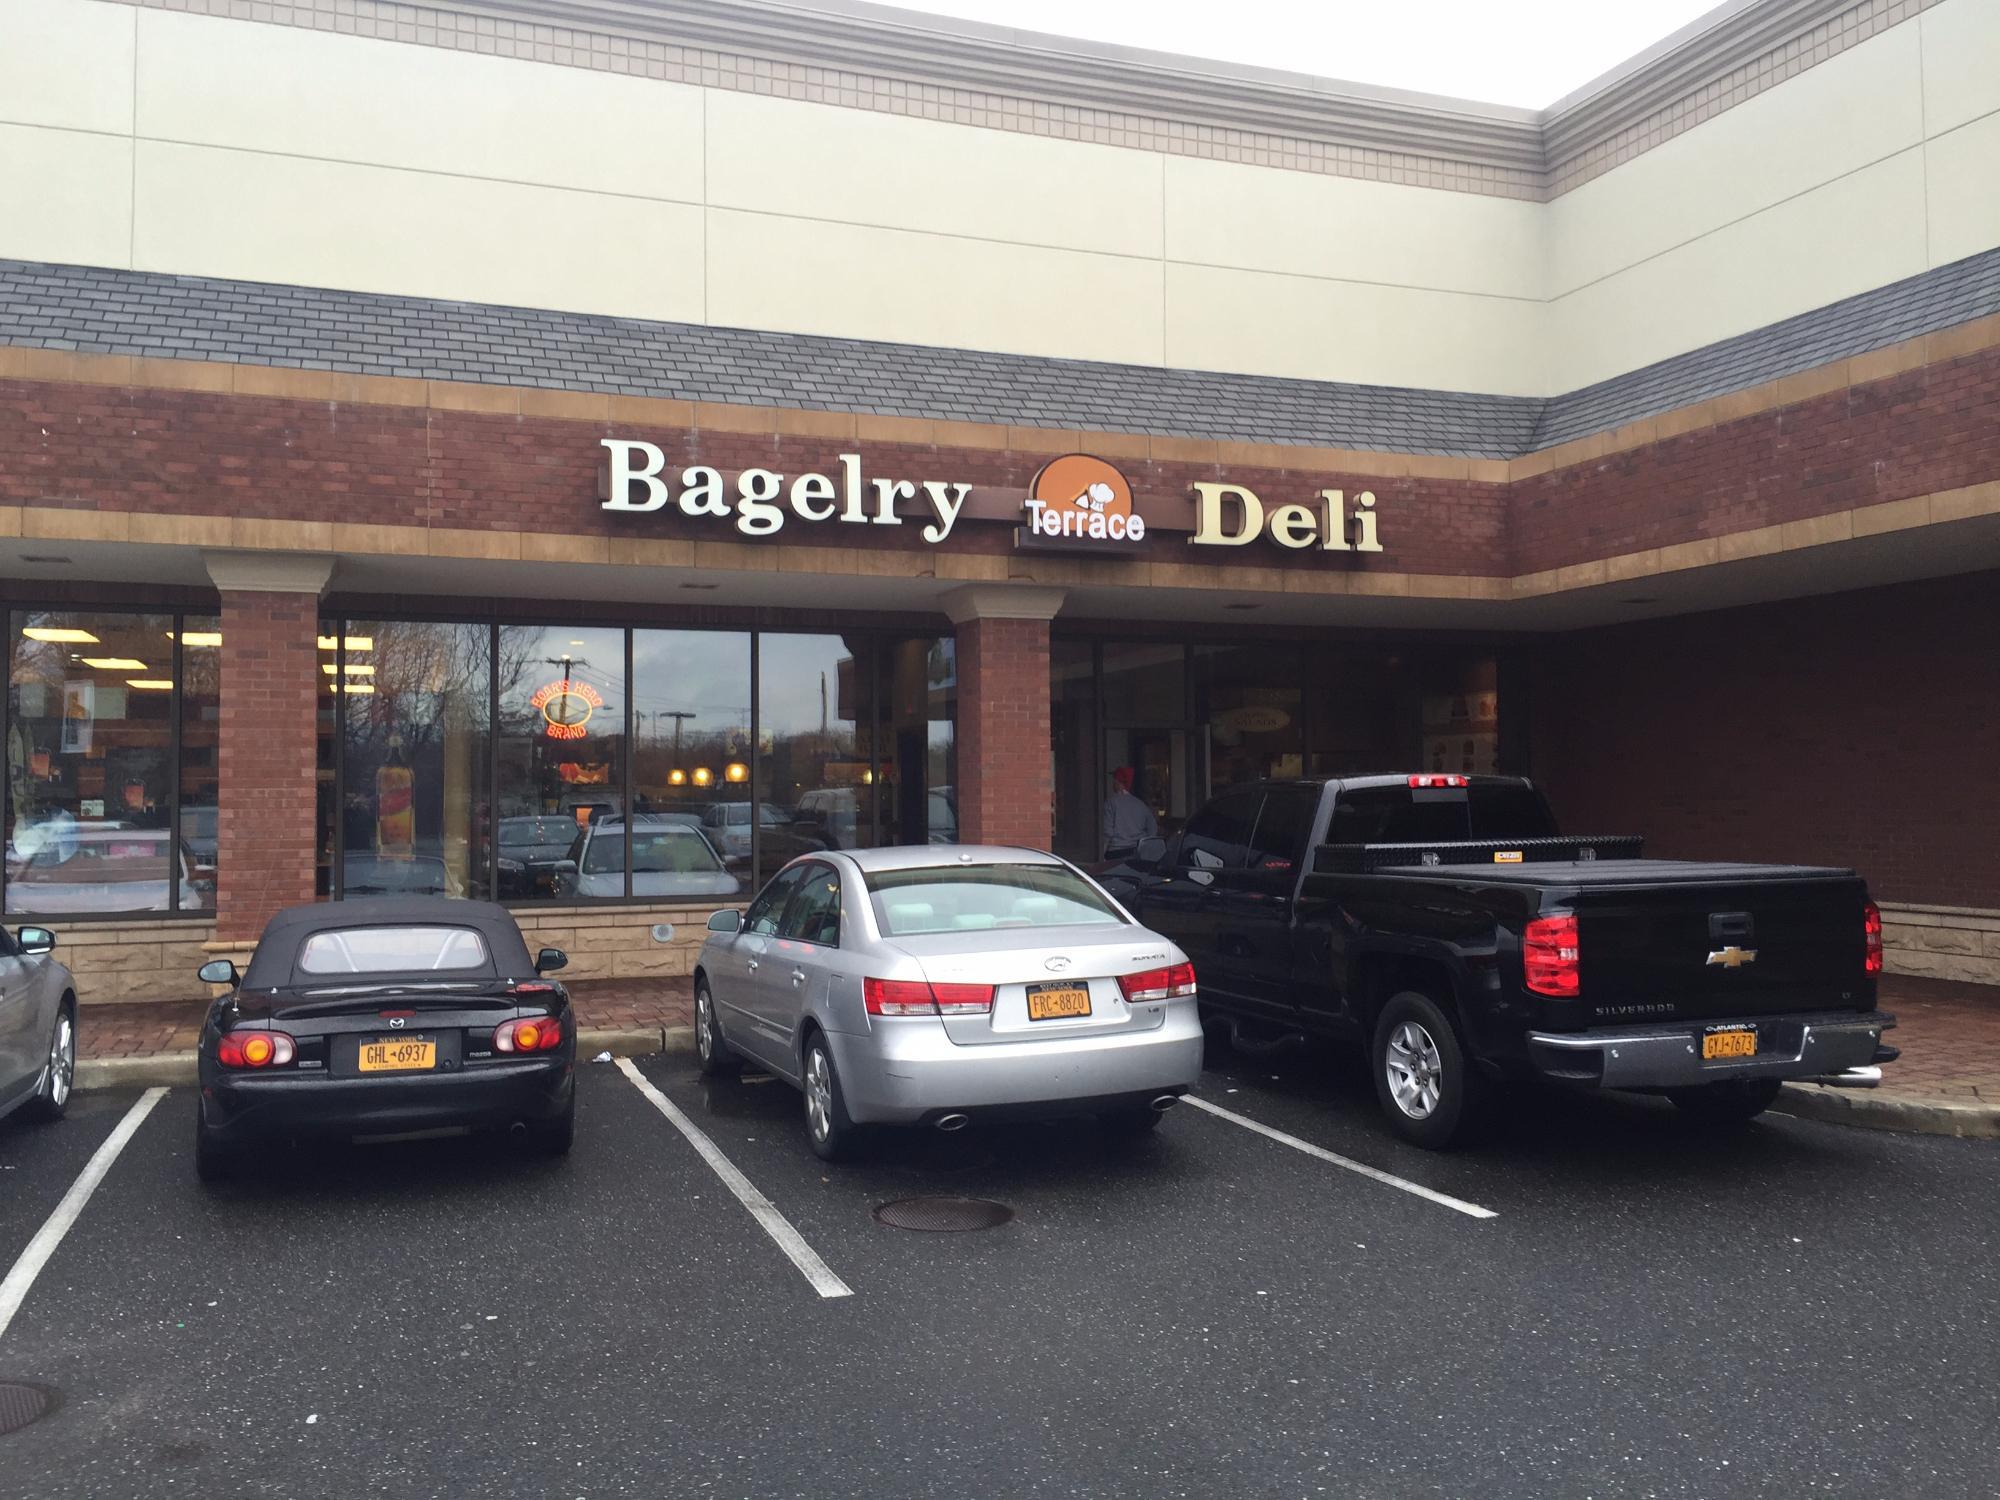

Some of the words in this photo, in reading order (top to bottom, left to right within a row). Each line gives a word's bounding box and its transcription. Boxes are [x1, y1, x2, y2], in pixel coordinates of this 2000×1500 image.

[600, 438, 973, 544] Bagelry
[1025, 499, 1145, 541] Terrace
[1190, 481, 1384, 552] Deli
[531, 680, 570, 708] BOAR'S
[574, 681, 604, 706] HEAD
[547, 724, 587, 740] BRAND
[1595, 1003, 1675, 1015] SILVERADO
